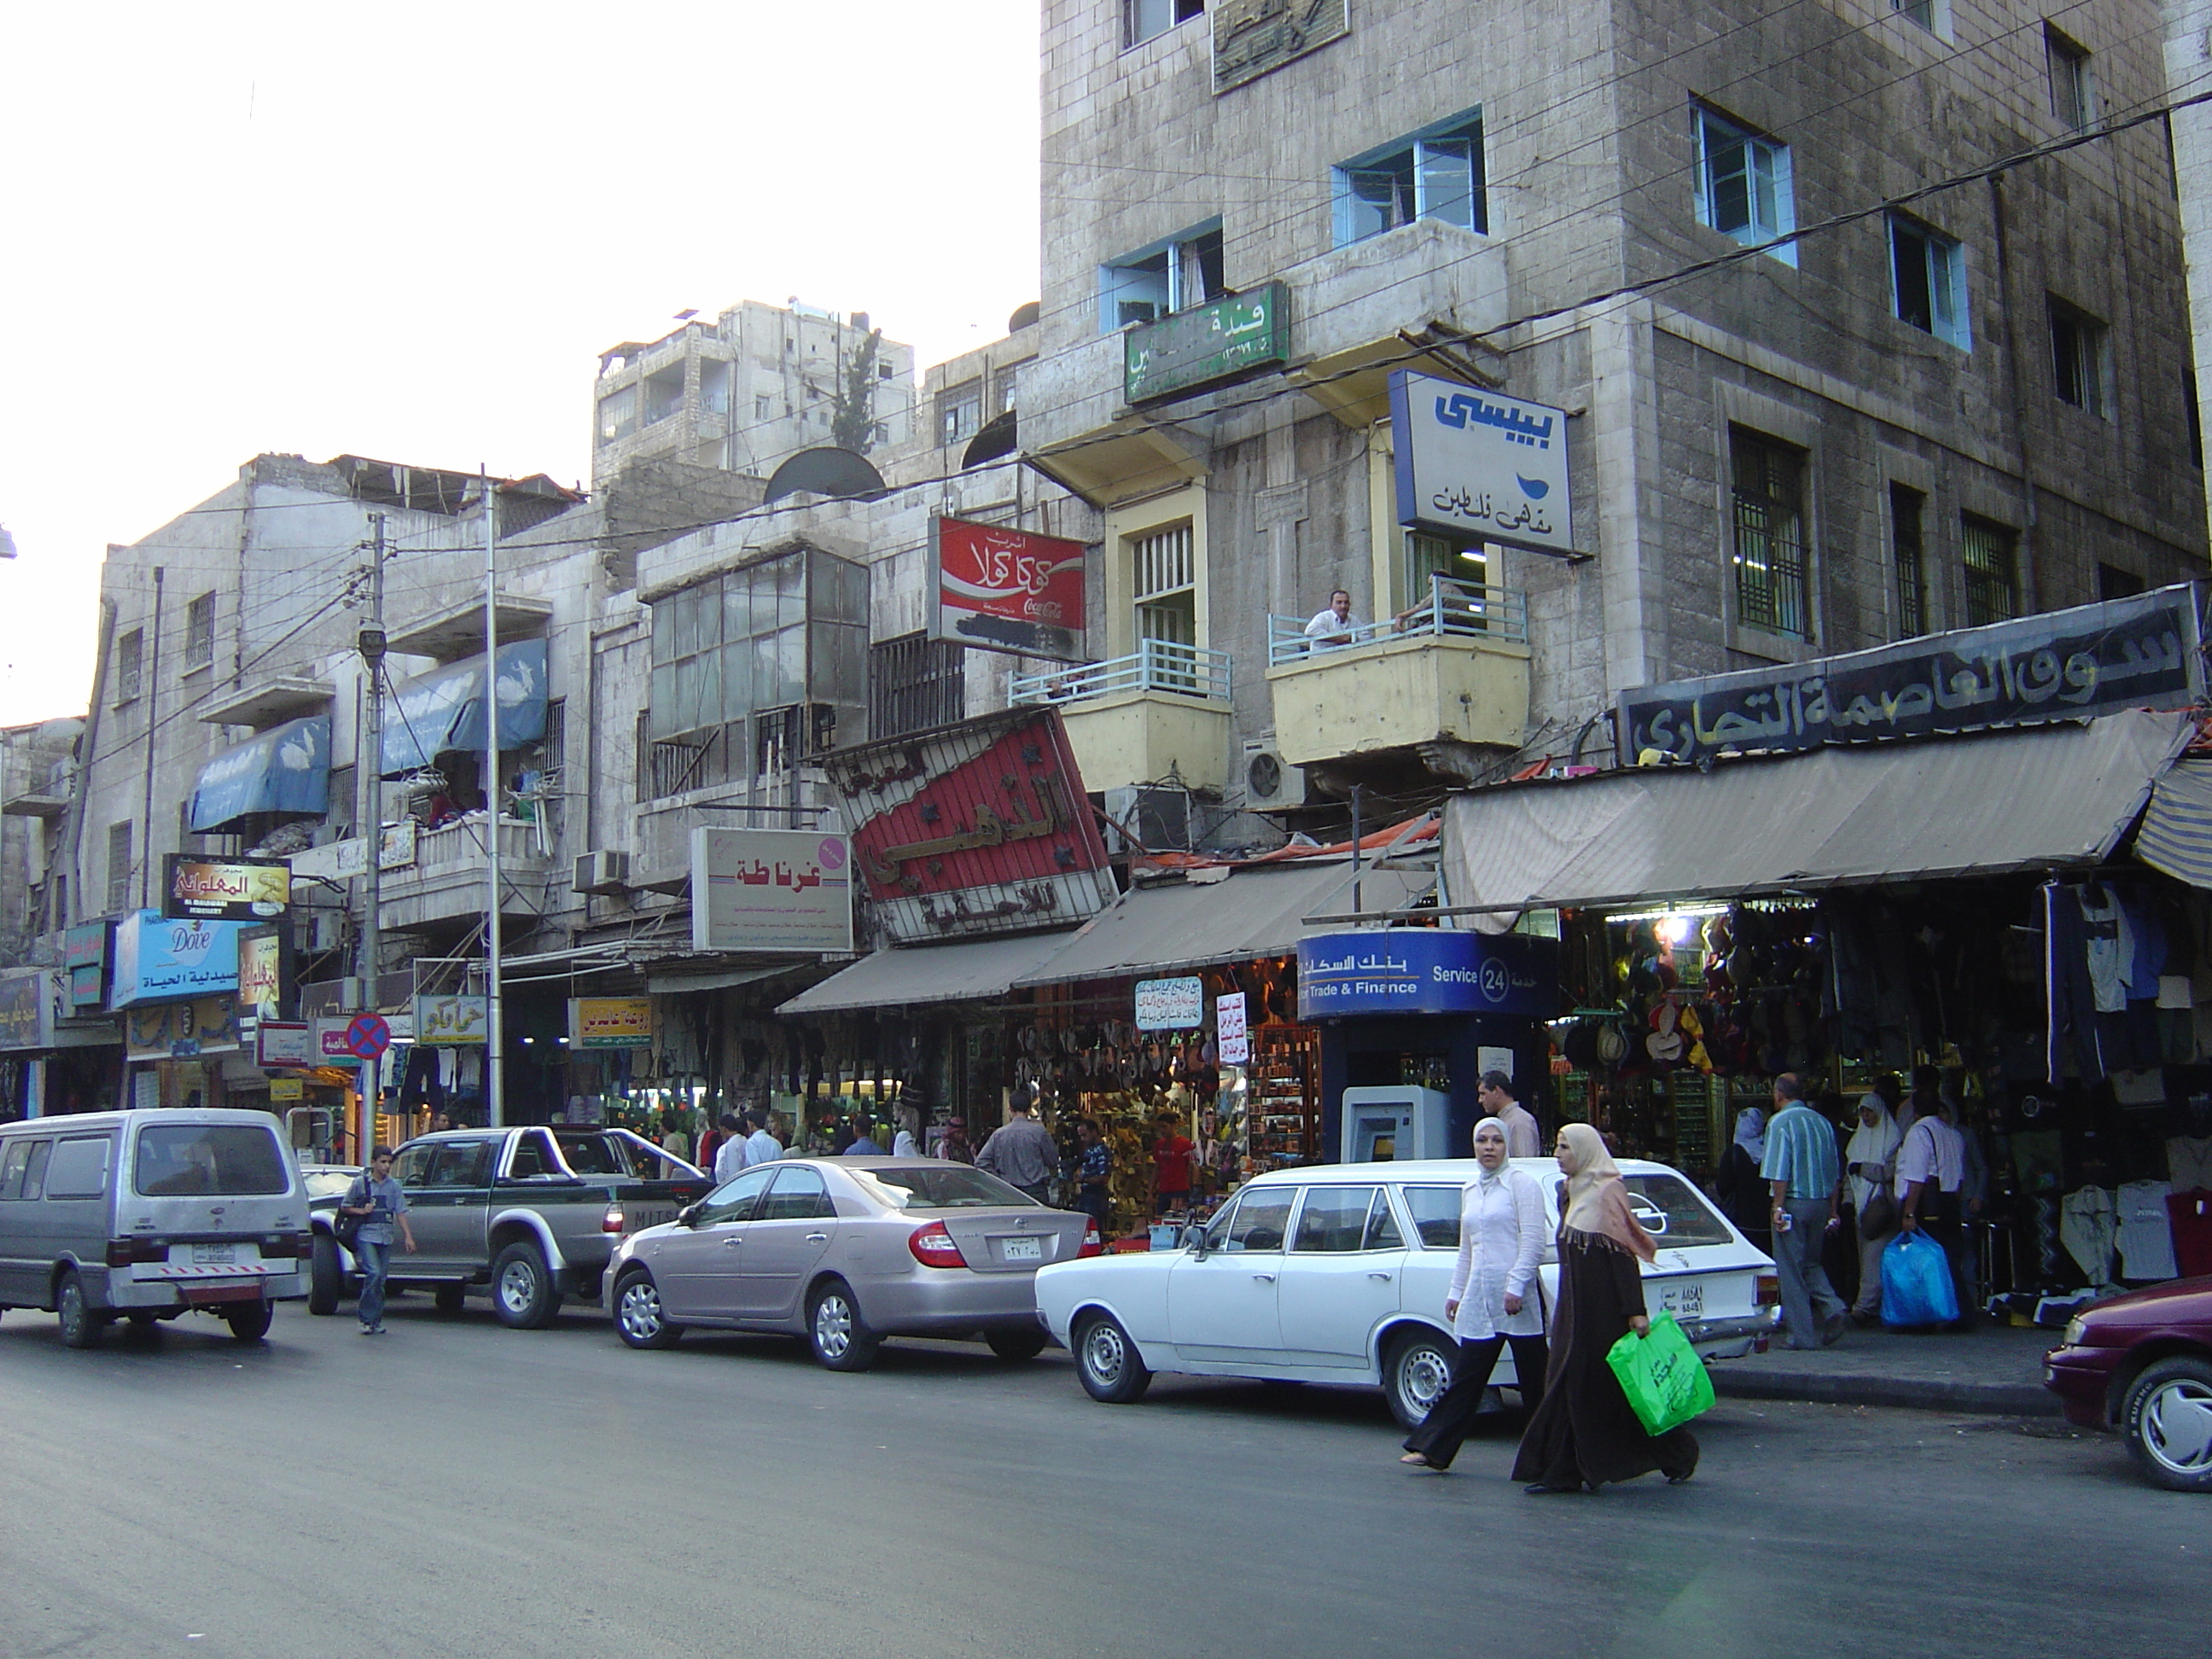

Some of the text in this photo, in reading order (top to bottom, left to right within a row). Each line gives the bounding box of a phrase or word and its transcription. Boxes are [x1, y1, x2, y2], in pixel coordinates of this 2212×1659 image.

[1433, 486, 1491, 519] فلسطين
[970, 542, 1012, 588] كولا
[2016, 629, 2181, 705] سوق
[1801, 643, 2016, 727] العاصمة
[736, 858, 821, 894] غرناطة
[172, 927, 211, 953] Dove
[1357, 954, 1406, 972] بنك
[1433, 965, 1505, 990] Service 24
[143, 970, 239, 989] صيدلية الحياة
[1310, 984, 1338, 998] Trade
[1341, 983, 1351, 995] &
[1355, 981, 1417, 994] Finance
